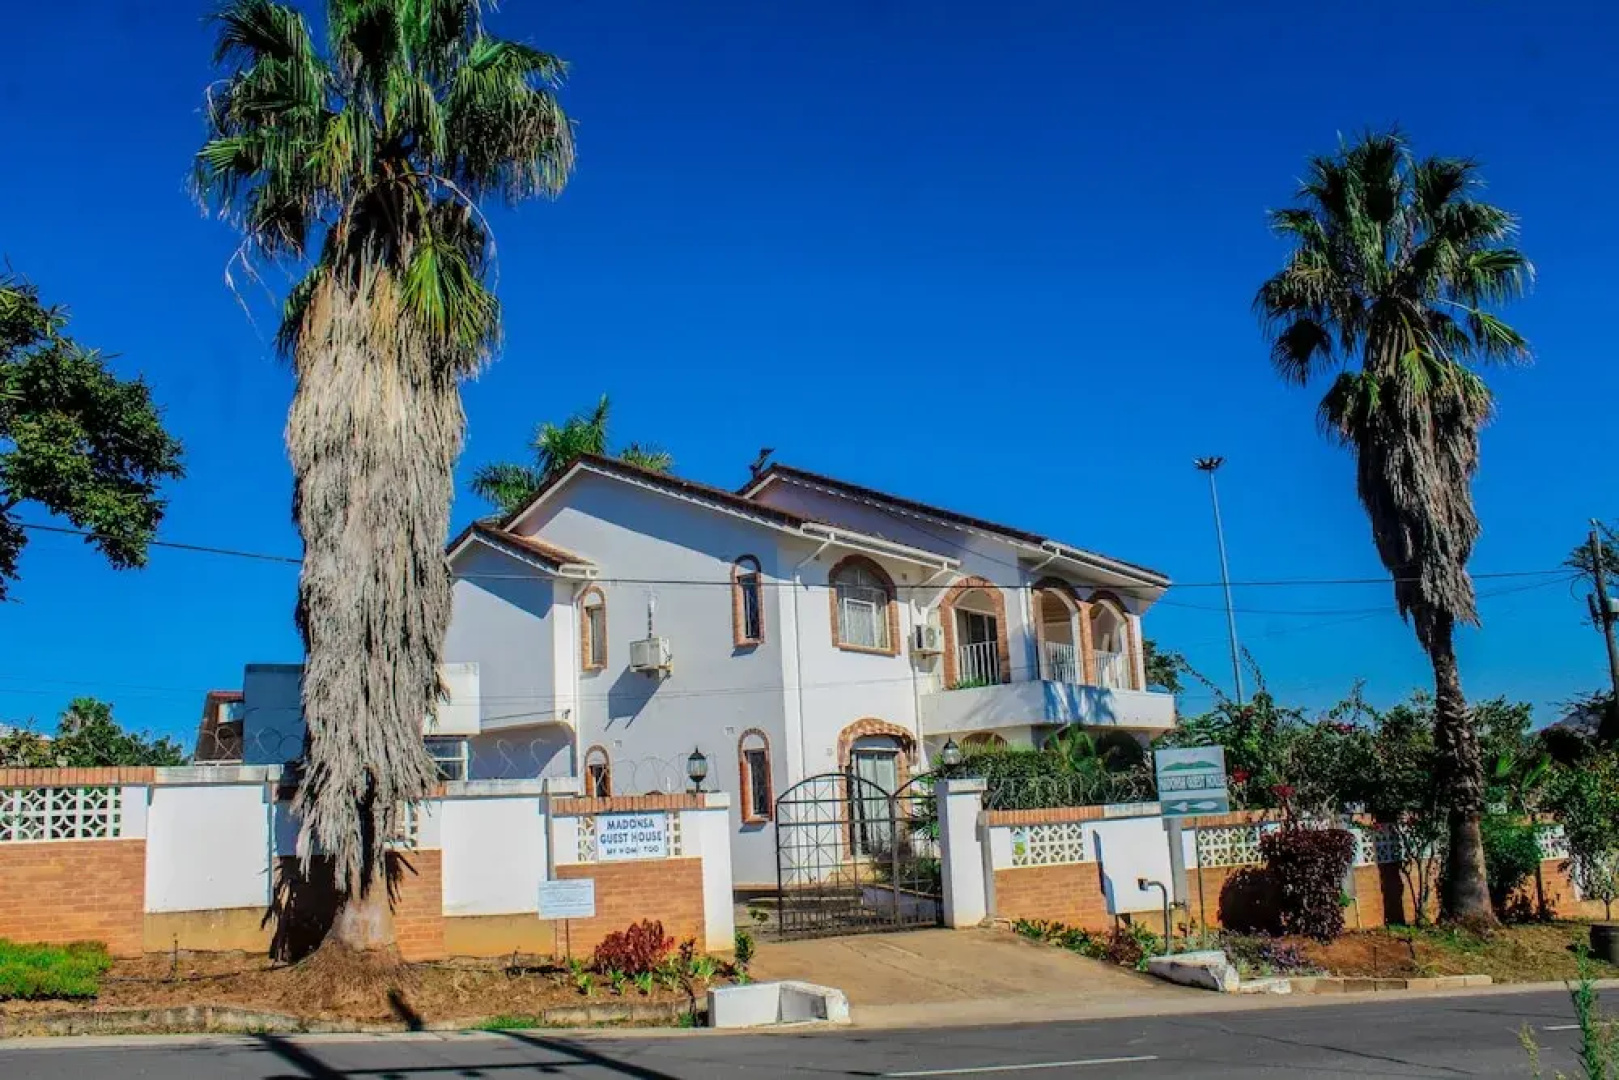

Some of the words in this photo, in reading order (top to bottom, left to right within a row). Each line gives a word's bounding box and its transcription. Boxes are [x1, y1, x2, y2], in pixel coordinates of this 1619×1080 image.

[607, 818, 655, 830] MADONSA
[600, 832, 628, 844] GUEST
[631, 831, 662, 843] HOUSE
